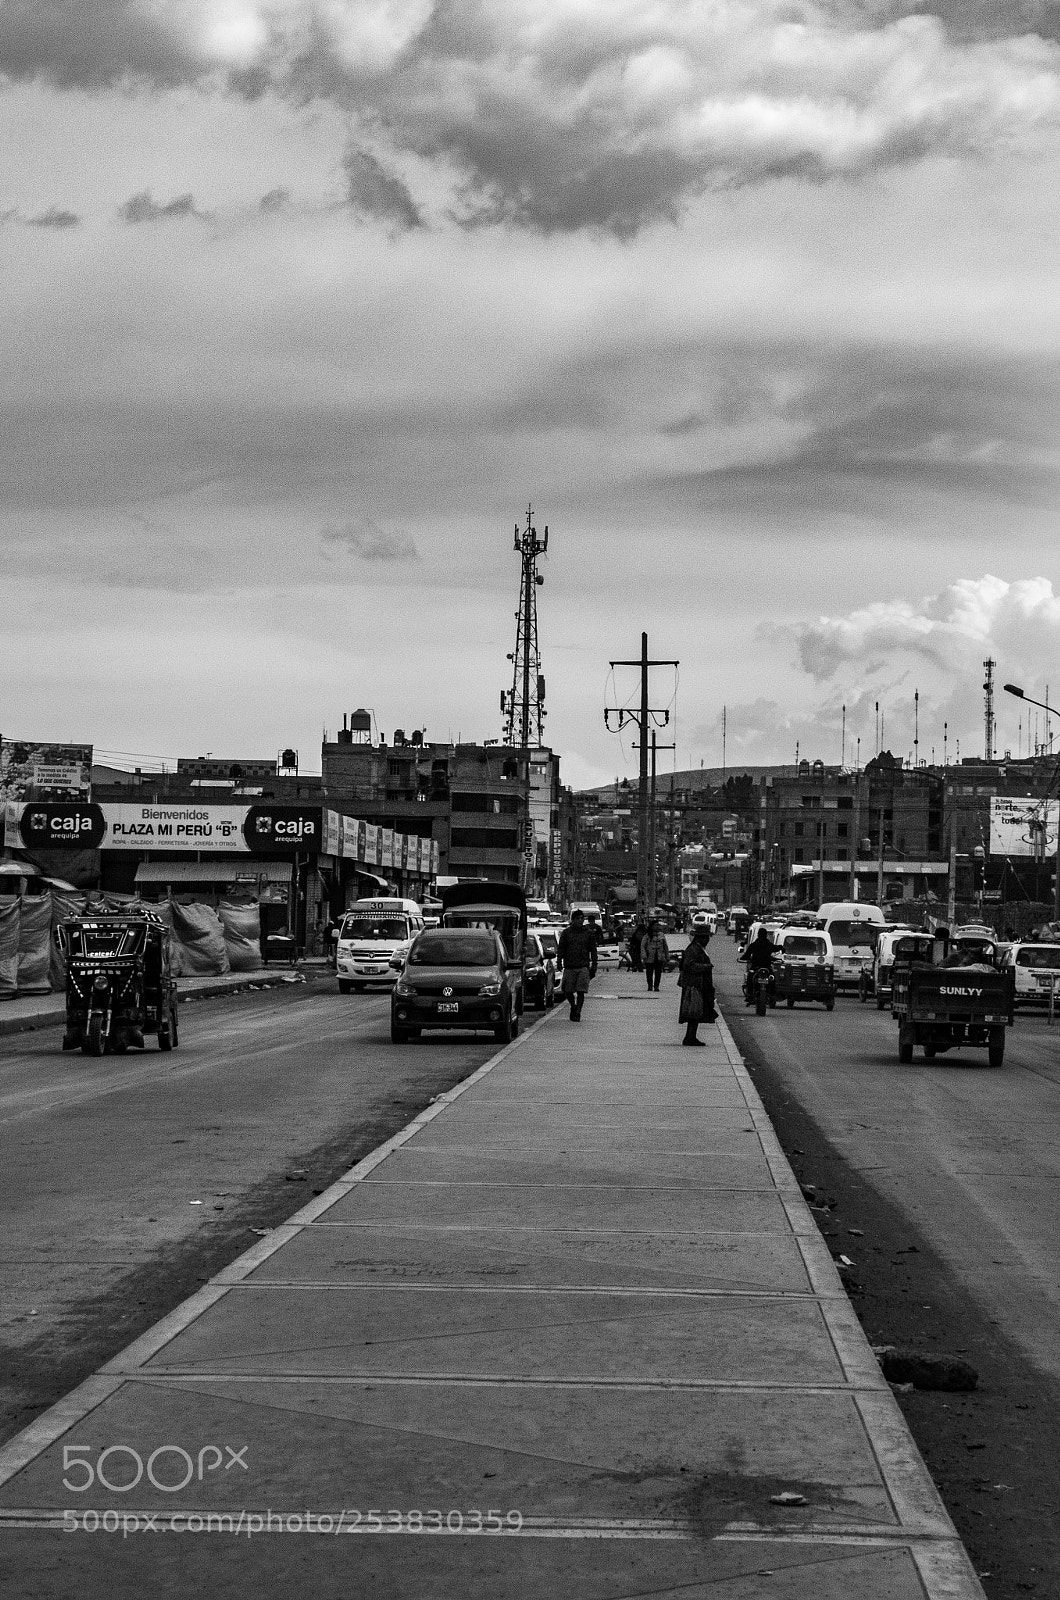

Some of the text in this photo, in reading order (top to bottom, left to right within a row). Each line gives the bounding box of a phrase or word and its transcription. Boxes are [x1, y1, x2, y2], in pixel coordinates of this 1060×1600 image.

[141, 808, 209, 820] Bienvenidos
[50, 813, 92, 832] caja
[113, 823, 154, 835] PLAZA
[158, 825, 172, 835] MI
[177, 822, 212, 836] PERÚ
[275, 817, 315, 836] caja
[940, 986, 982, 996] SUNLYY
